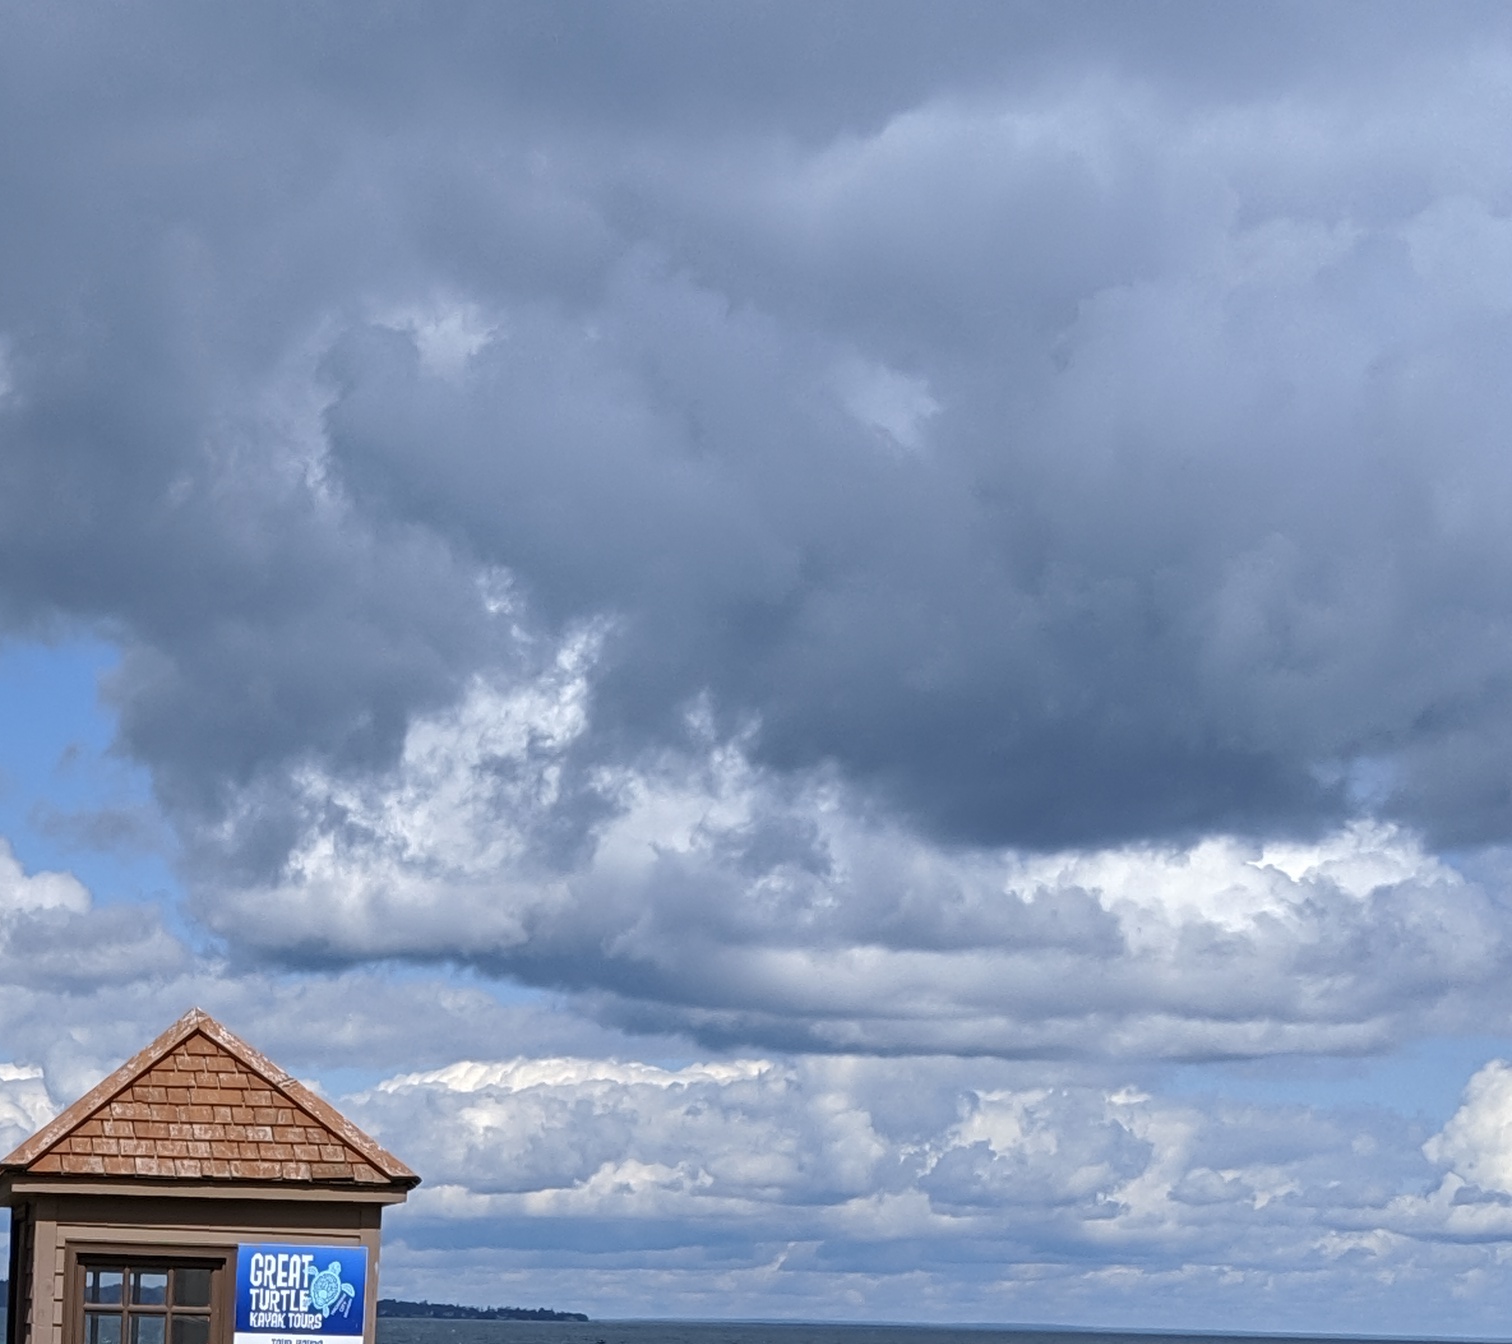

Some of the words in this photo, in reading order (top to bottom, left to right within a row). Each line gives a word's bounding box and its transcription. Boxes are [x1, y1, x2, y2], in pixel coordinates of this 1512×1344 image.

[249, 1252, 314, 1290] GREAT
[249, 1288, 310, 1313] TURTLE
[249, 1311, 286, 1329] KAYAK
[287, 1313, 323, 1330] TOURS
